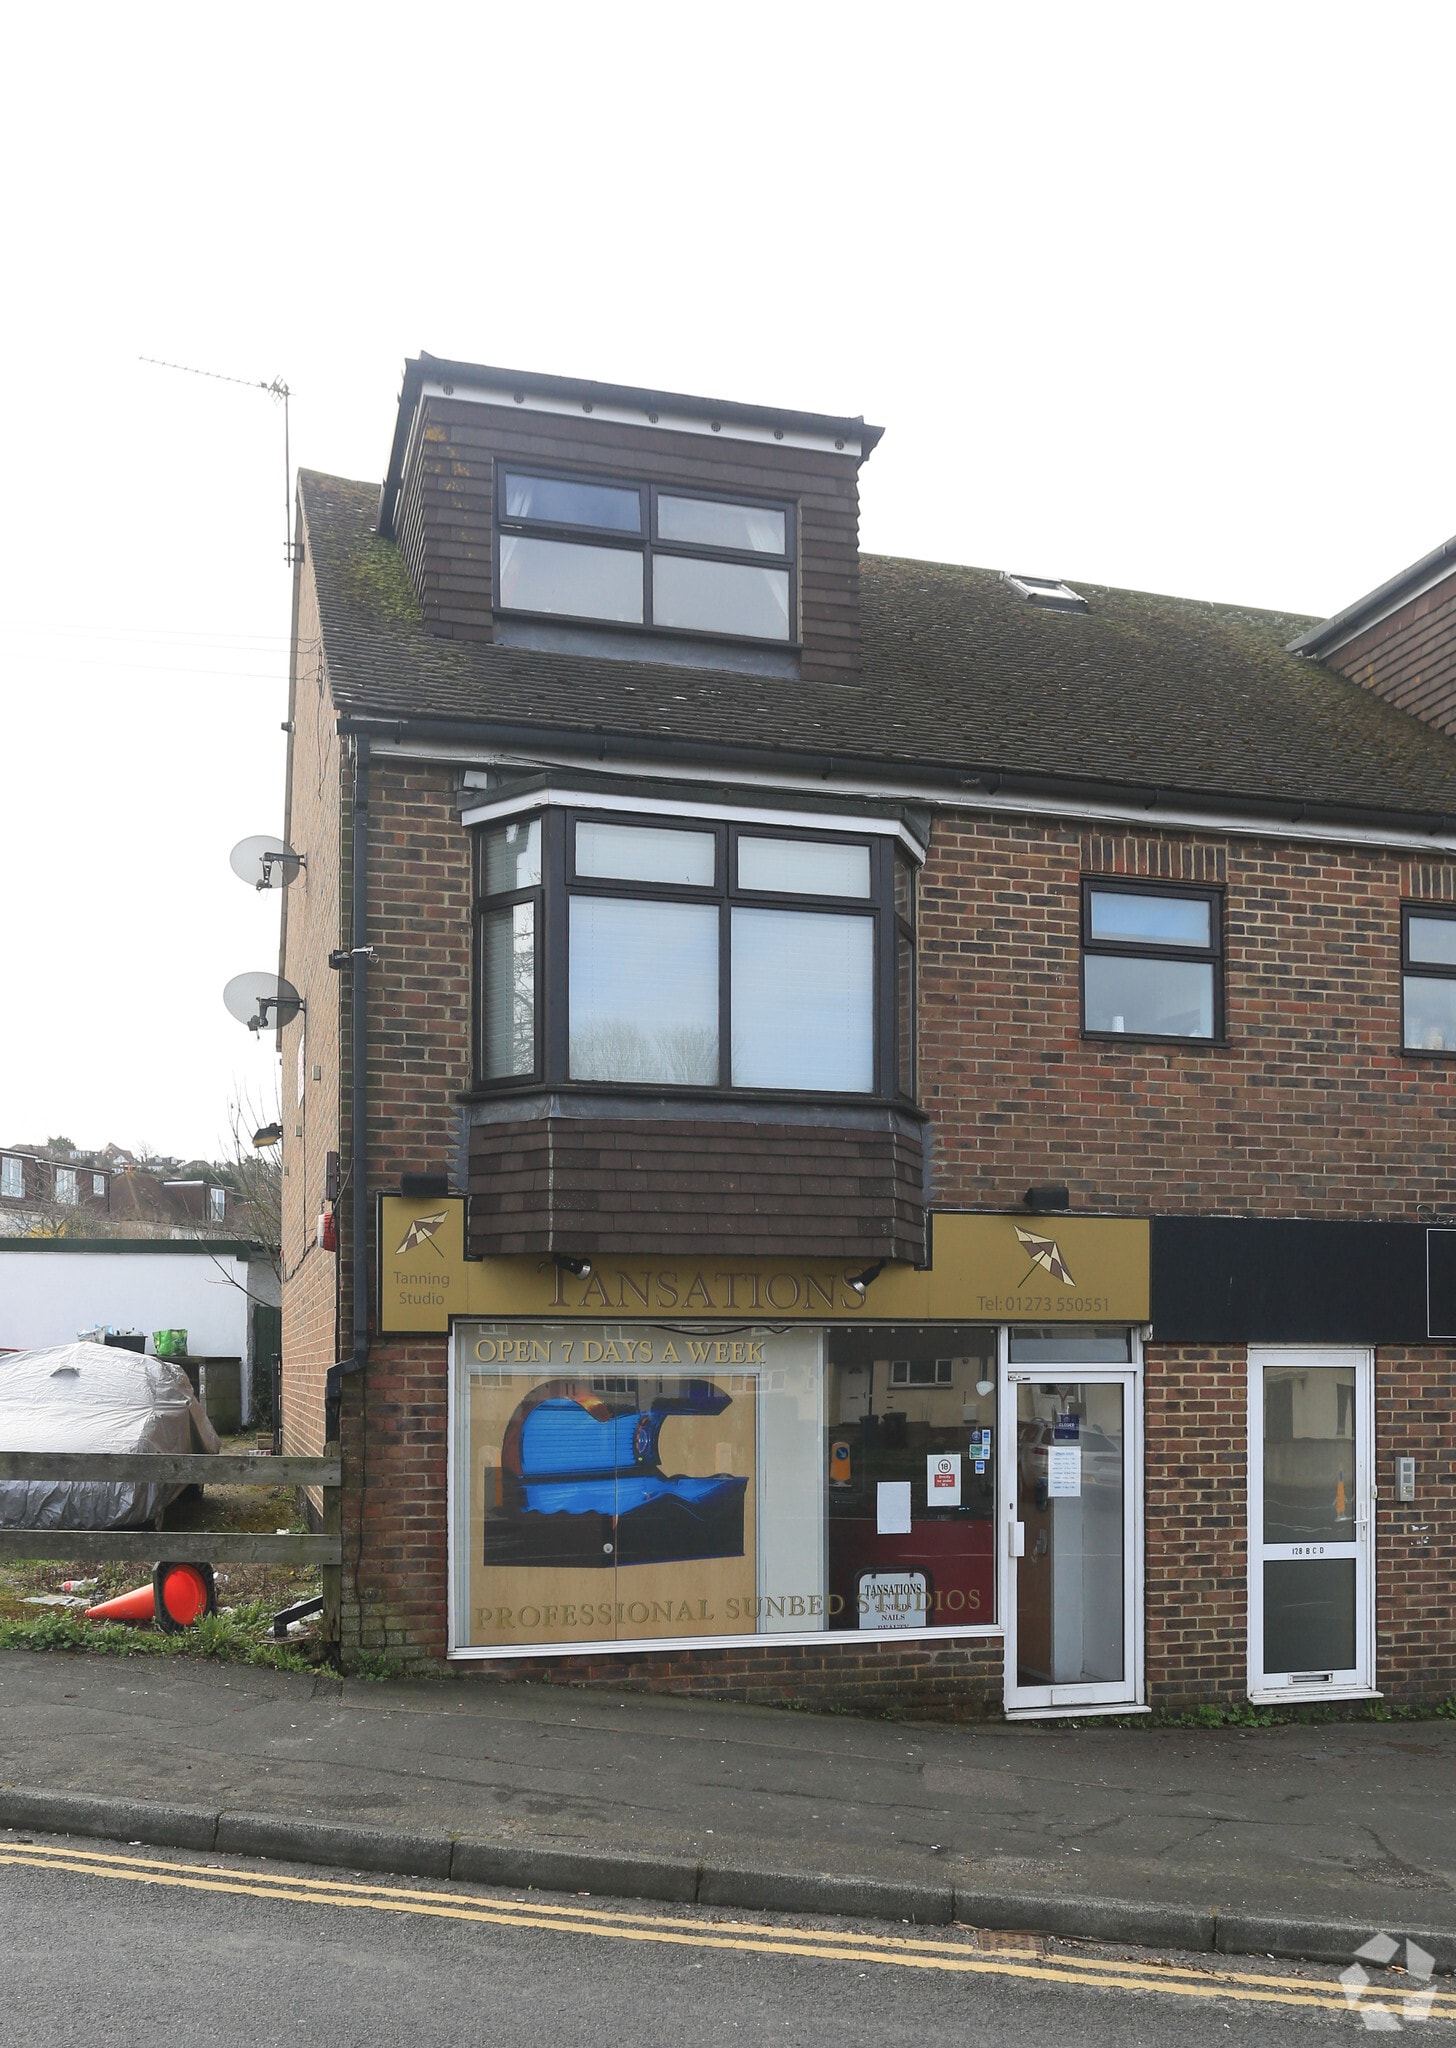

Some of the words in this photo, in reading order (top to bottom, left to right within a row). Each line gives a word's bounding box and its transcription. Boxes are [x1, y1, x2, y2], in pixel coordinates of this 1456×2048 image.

[393, 1271, 450, 1288] Tanning
[537, 1261, 866, 1310] TANSATIONS
[399, 1291, 445, 1305] Studio
[976, 1295, 1003, 1311] Tel:
[1005, 1296, 1052, 1312] 01273
[1056, 1297, 1110, 1312] 550551
[474, 1339, 552, 1363] OPEN
[561, 1341, 575, 1363] 7
[582, 1340, 654, 1363] DAYS
[660, 1341, 682, 1363] A
[686, 1341, 767, 1363] WEEK
[1292, 1547, 1303, 1555] 128
[1305, 1547, 1310, 1555] B
[1312, 1546, 1317, 1554] C
[1319, 1546, 1324, 1554] D
[865, 1583, 922, 1599] TANSATIONS
[475, 1599, 715, 1630] PROFESSIONAL
[725, 1594, 844, 1619] SUNBED
[856, 1589, 981, 1614] STUDIOS
